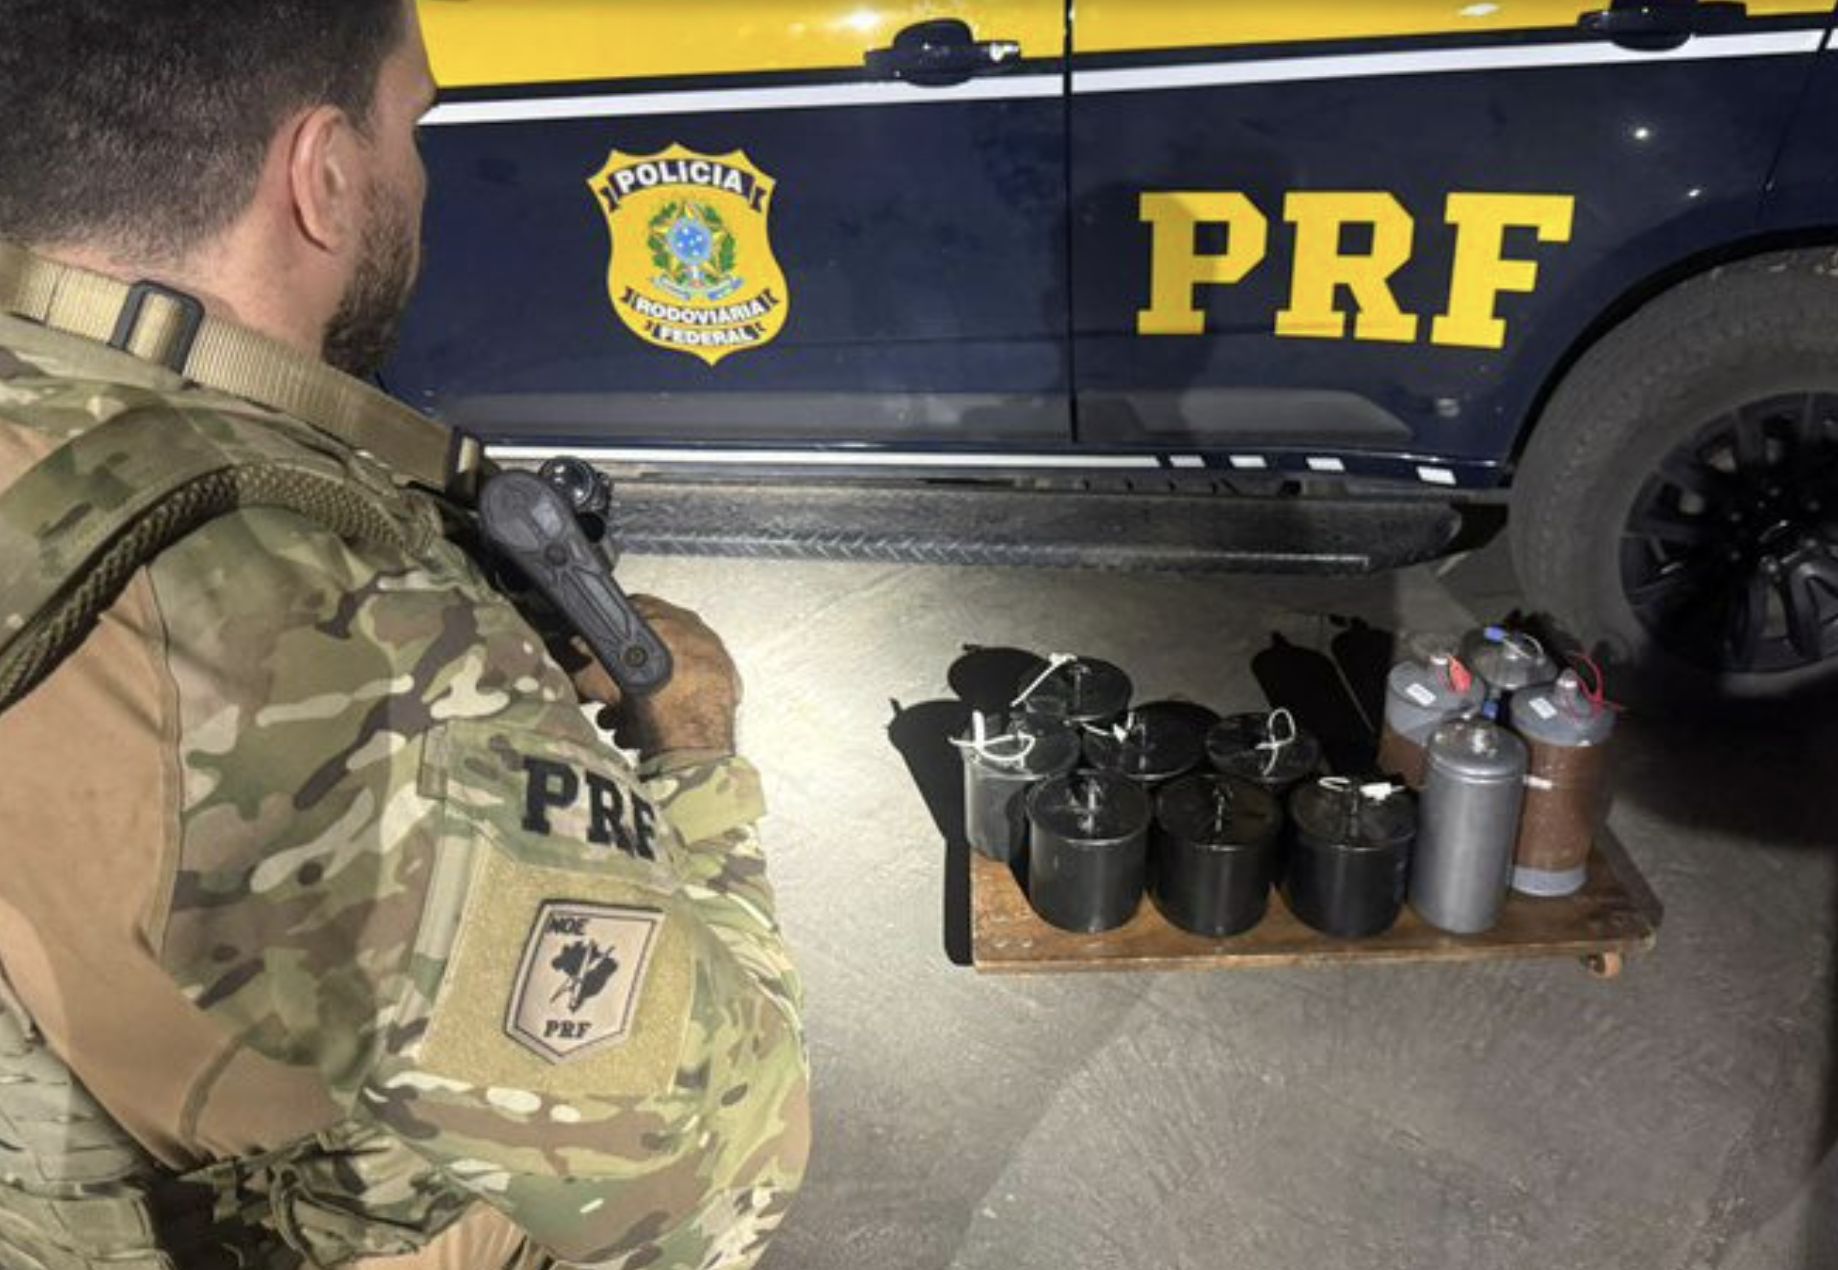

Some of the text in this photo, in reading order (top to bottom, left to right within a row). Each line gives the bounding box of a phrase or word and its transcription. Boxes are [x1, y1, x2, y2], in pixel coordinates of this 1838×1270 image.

[1137, 191, 1575, 349] PRF
[659, 324, 754, 346] FEDERAL
[521, 755, 655, 861] PRF
[543, 1020, 593, 1038] PRF
